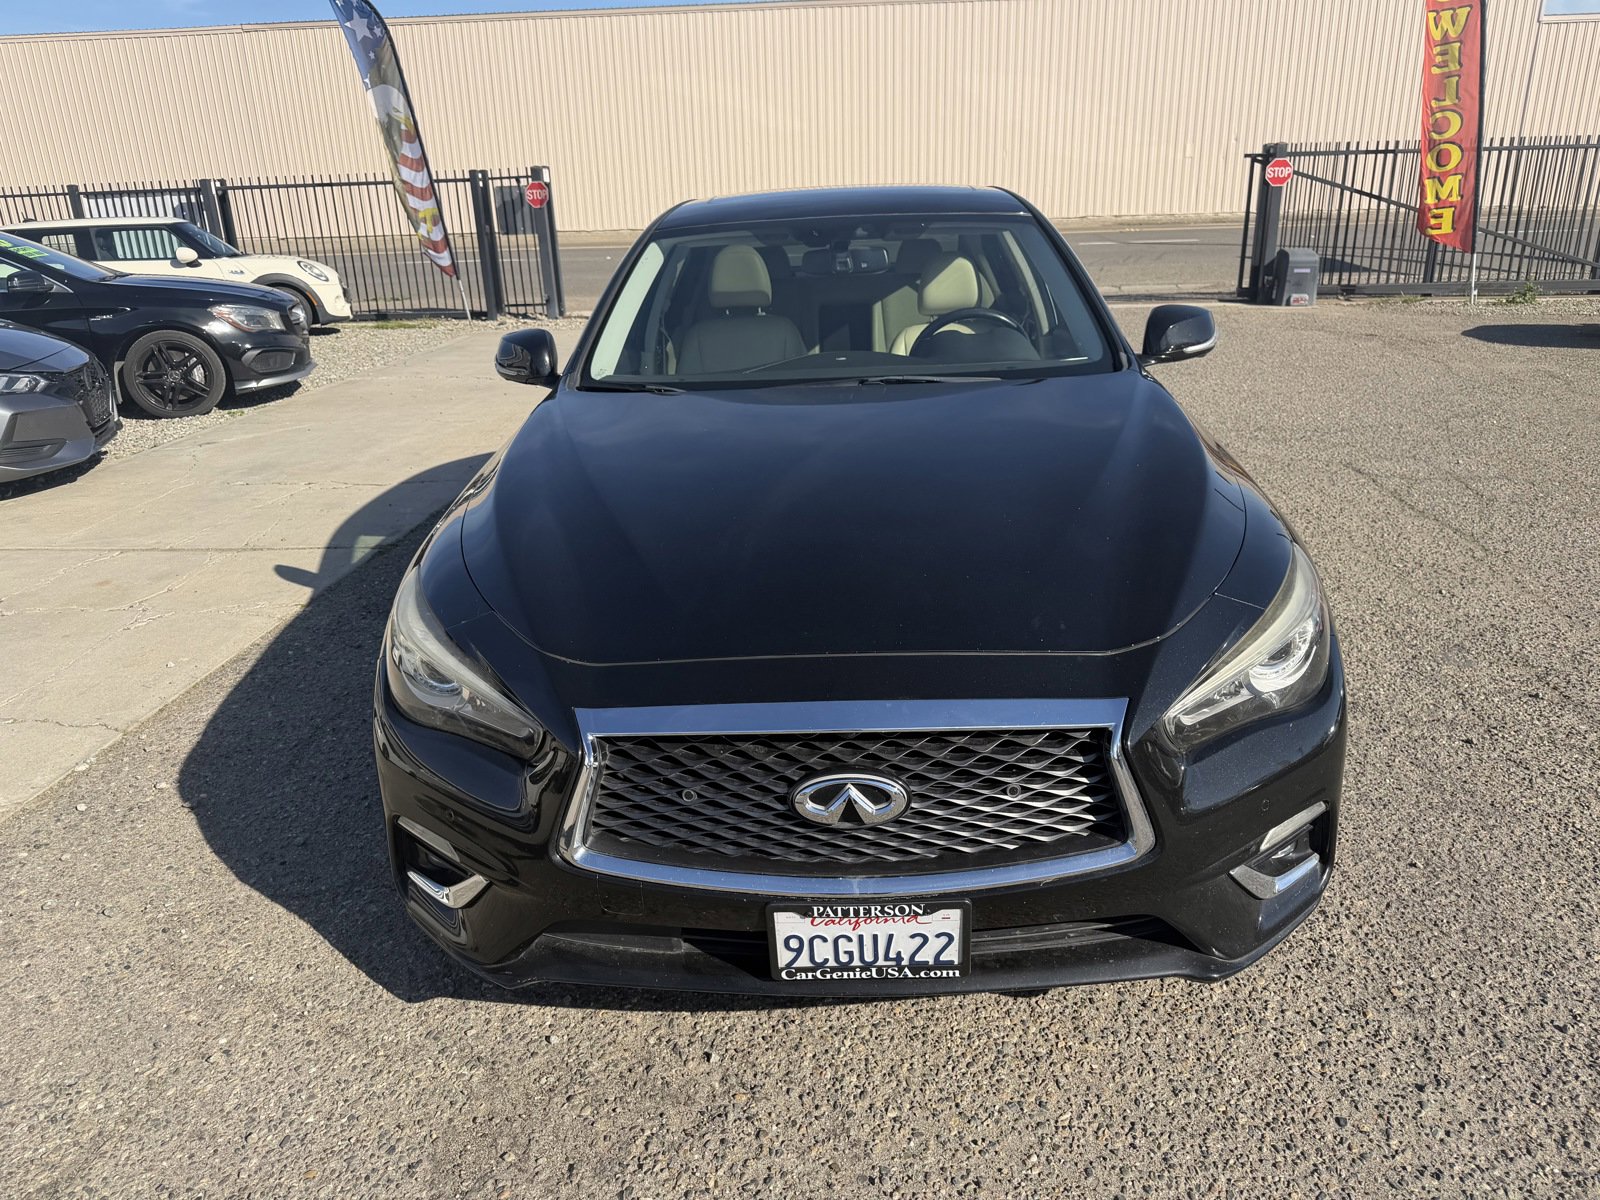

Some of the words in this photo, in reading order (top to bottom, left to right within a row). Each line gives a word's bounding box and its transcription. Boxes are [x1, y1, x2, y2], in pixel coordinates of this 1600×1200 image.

[1267, 167, 1292, 178] STOP
[527, 189, 547, 200] STOP
[812, 904, 925, 917] PATTERSON
[783, 932, 956, 967] 9CGU422
[781, 967, 961, 981] CarGenieUSA.com
